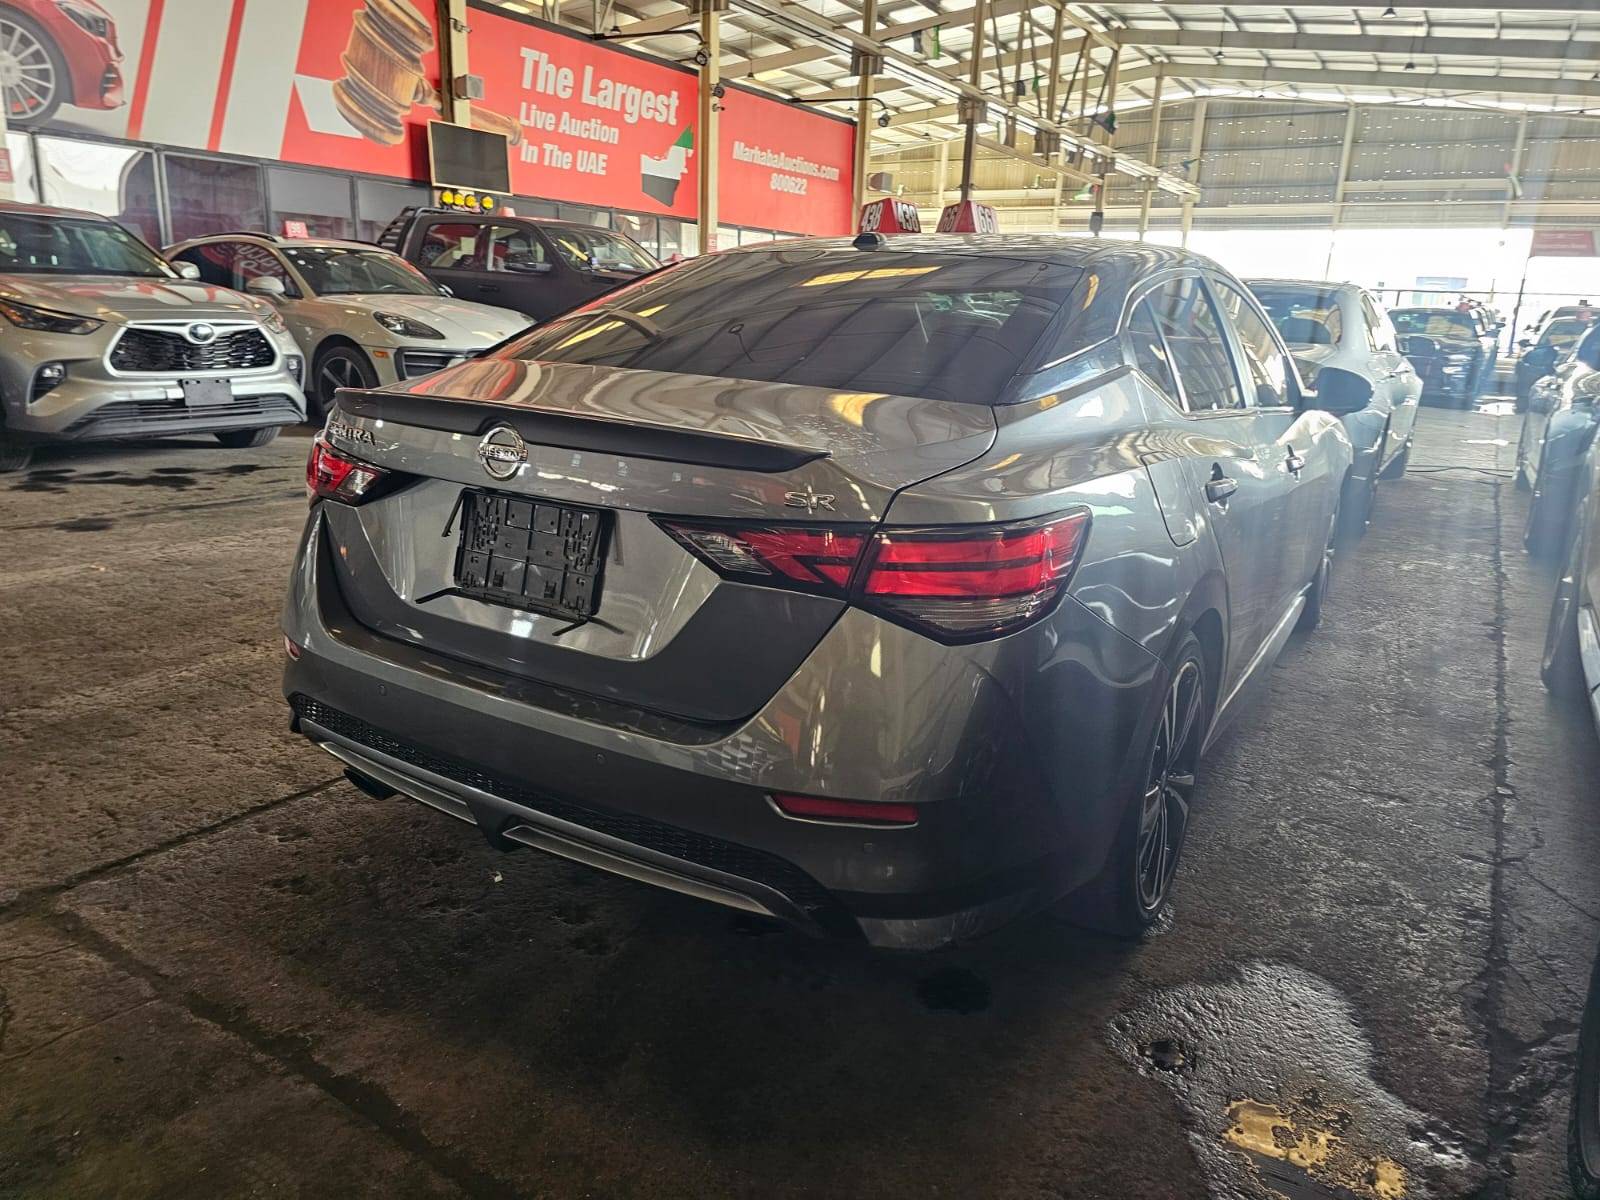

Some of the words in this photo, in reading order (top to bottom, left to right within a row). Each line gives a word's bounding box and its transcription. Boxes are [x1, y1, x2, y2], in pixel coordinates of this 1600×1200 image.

[520, 46, 575, 99] The
[581, 65, 680, 126] Largest
[519, 102, 557, 132] Live
[558, 111, 620, 145] Auction
[520, 139, 539, 164] In
[542, 143, 573, 170] The
[576, 149, 609, 176] UAE
